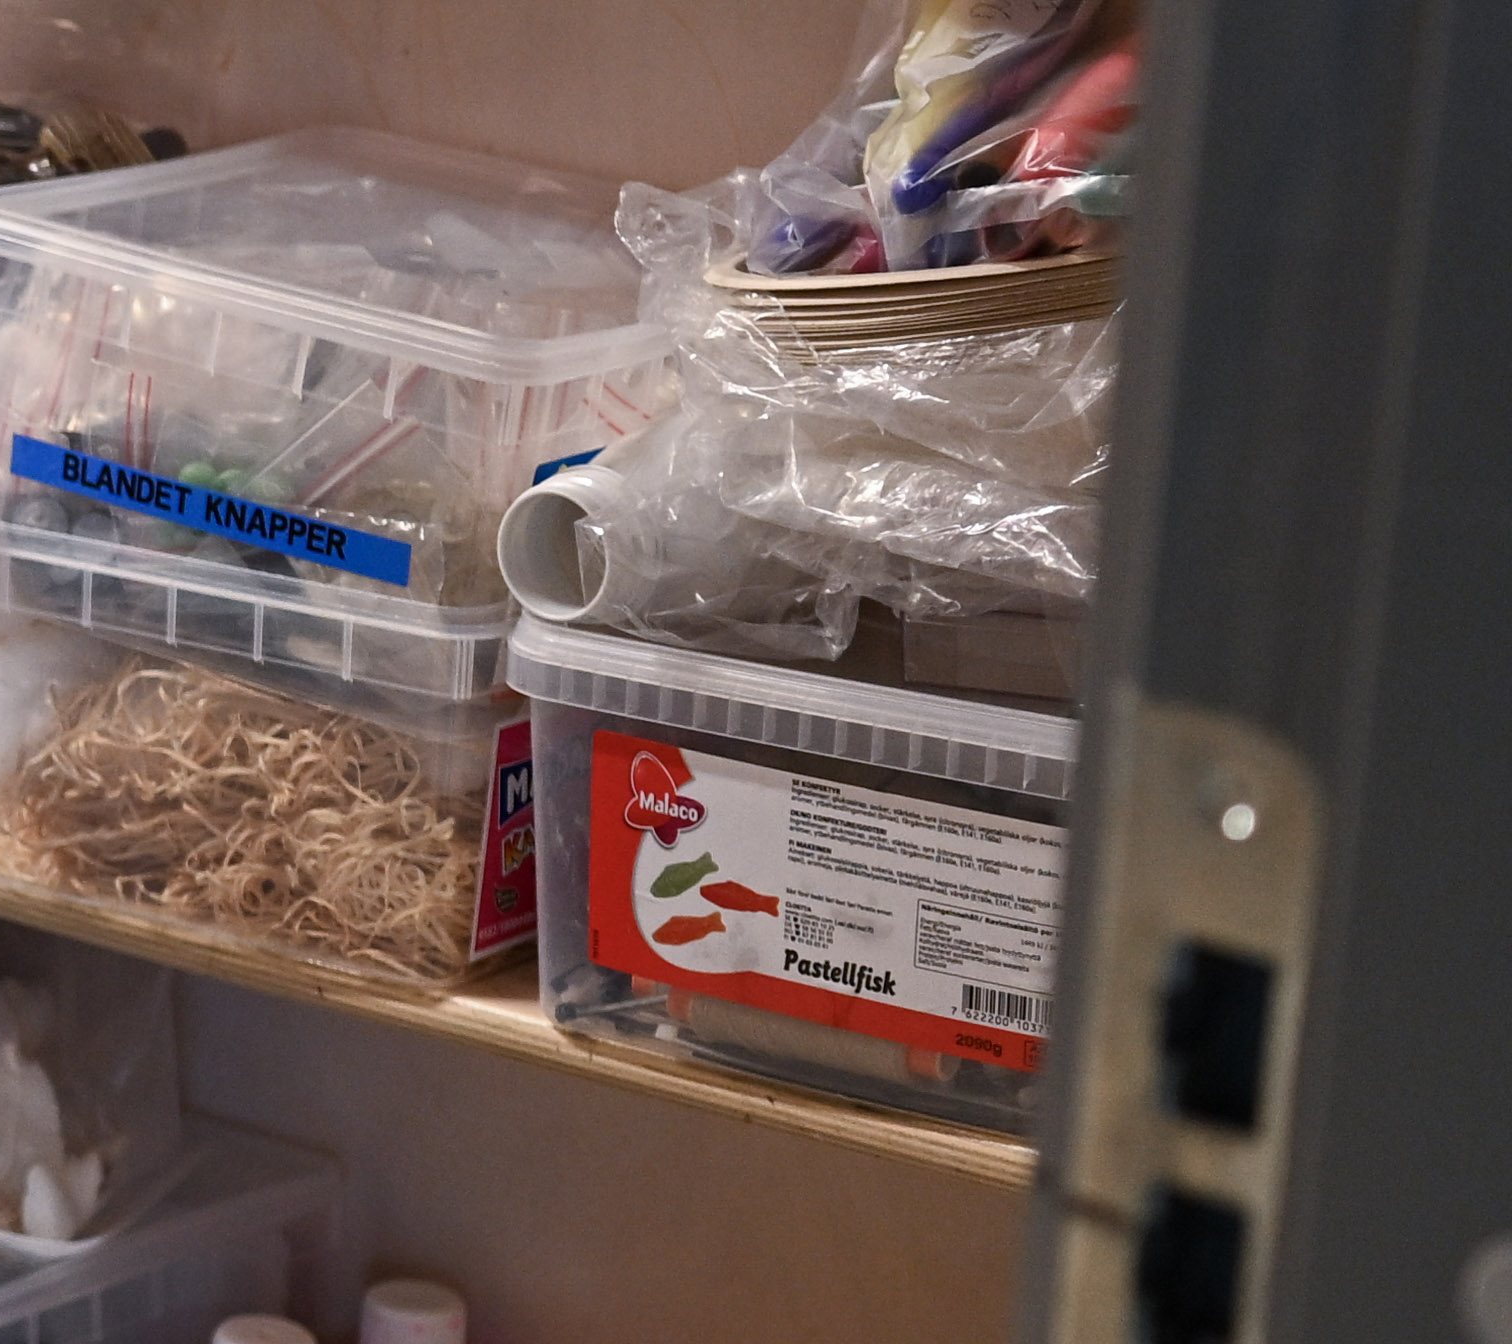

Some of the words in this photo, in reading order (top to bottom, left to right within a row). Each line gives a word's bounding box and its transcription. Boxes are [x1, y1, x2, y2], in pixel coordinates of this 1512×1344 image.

[63, 452, 193, 516] BLANDET
[205, 493, 348, 561] KNAPPER
[639, 789, 699, 823] Malaco
[783, 947, 897, 997] Pastellfisk
